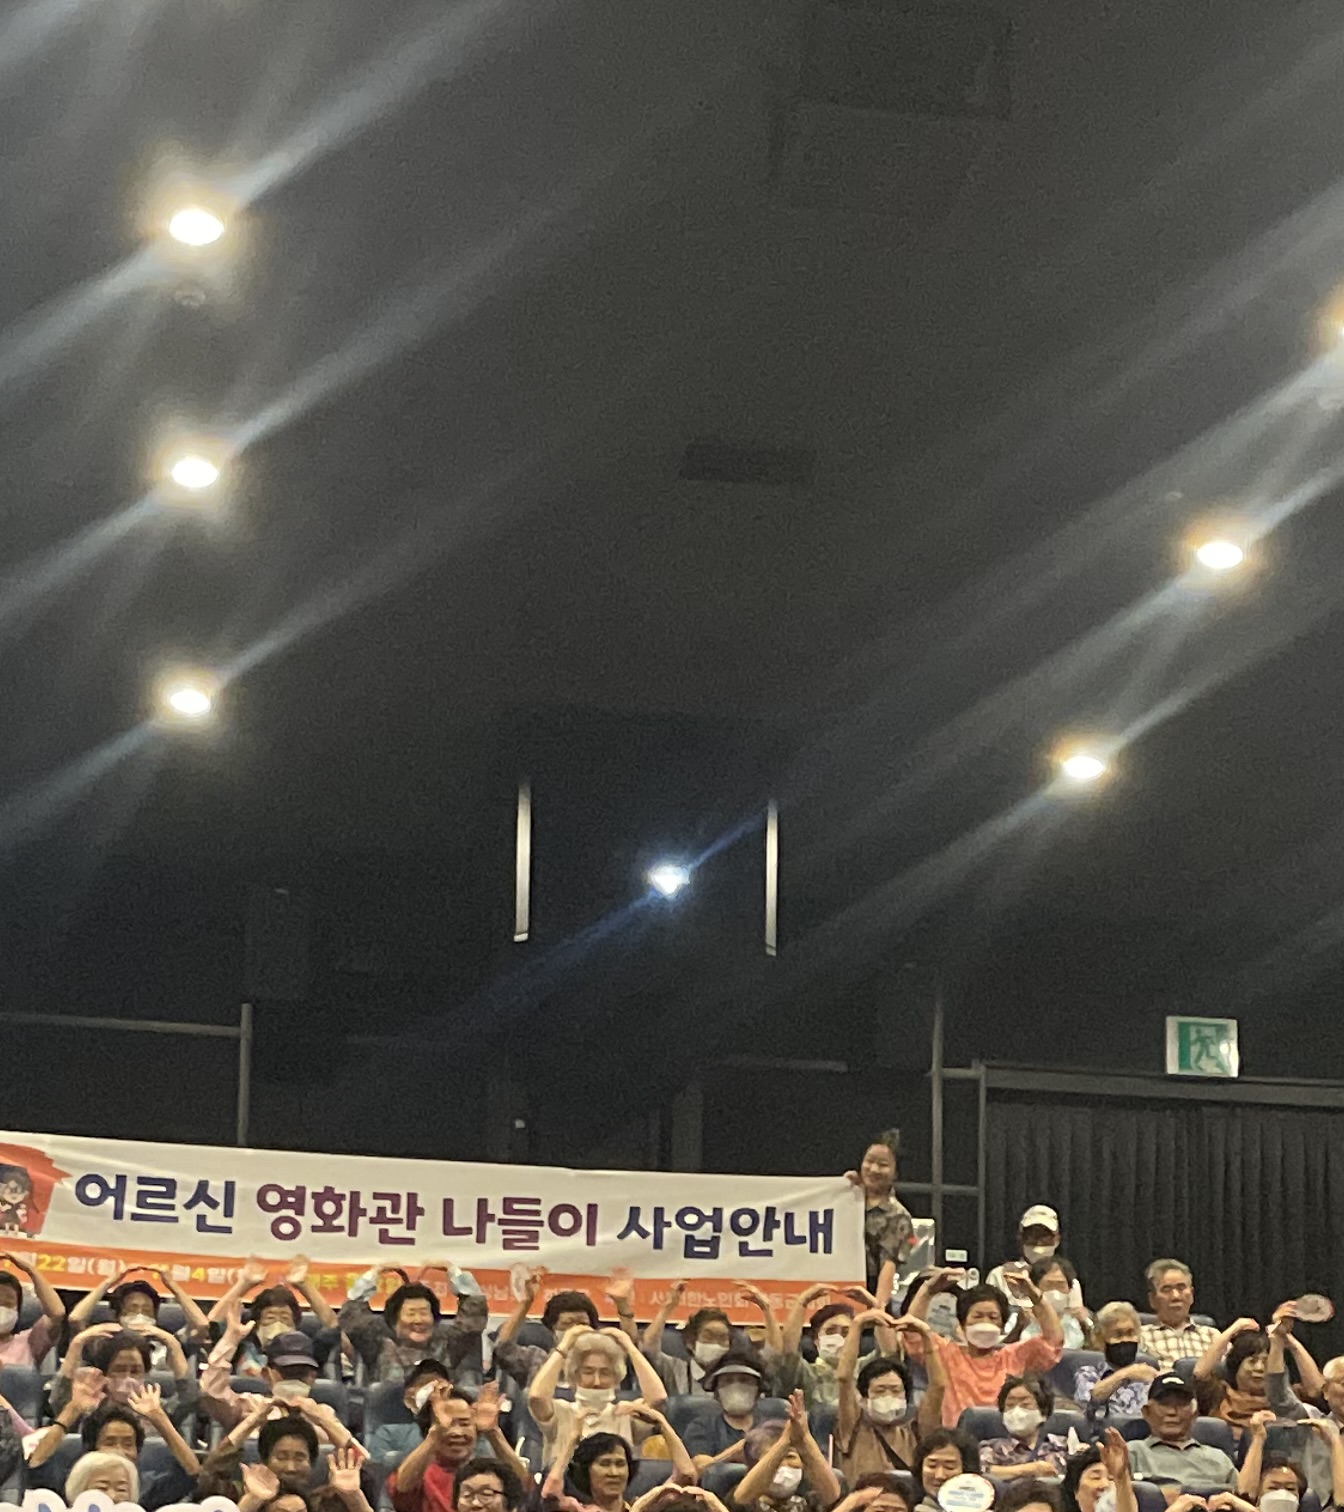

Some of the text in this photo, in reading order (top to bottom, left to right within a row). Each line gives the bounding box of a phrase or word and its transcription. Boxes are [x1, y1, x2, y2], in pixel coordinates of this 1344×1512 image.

[75, 1173, 834, 1260] 어르신 영화관 나들이 사업안내
